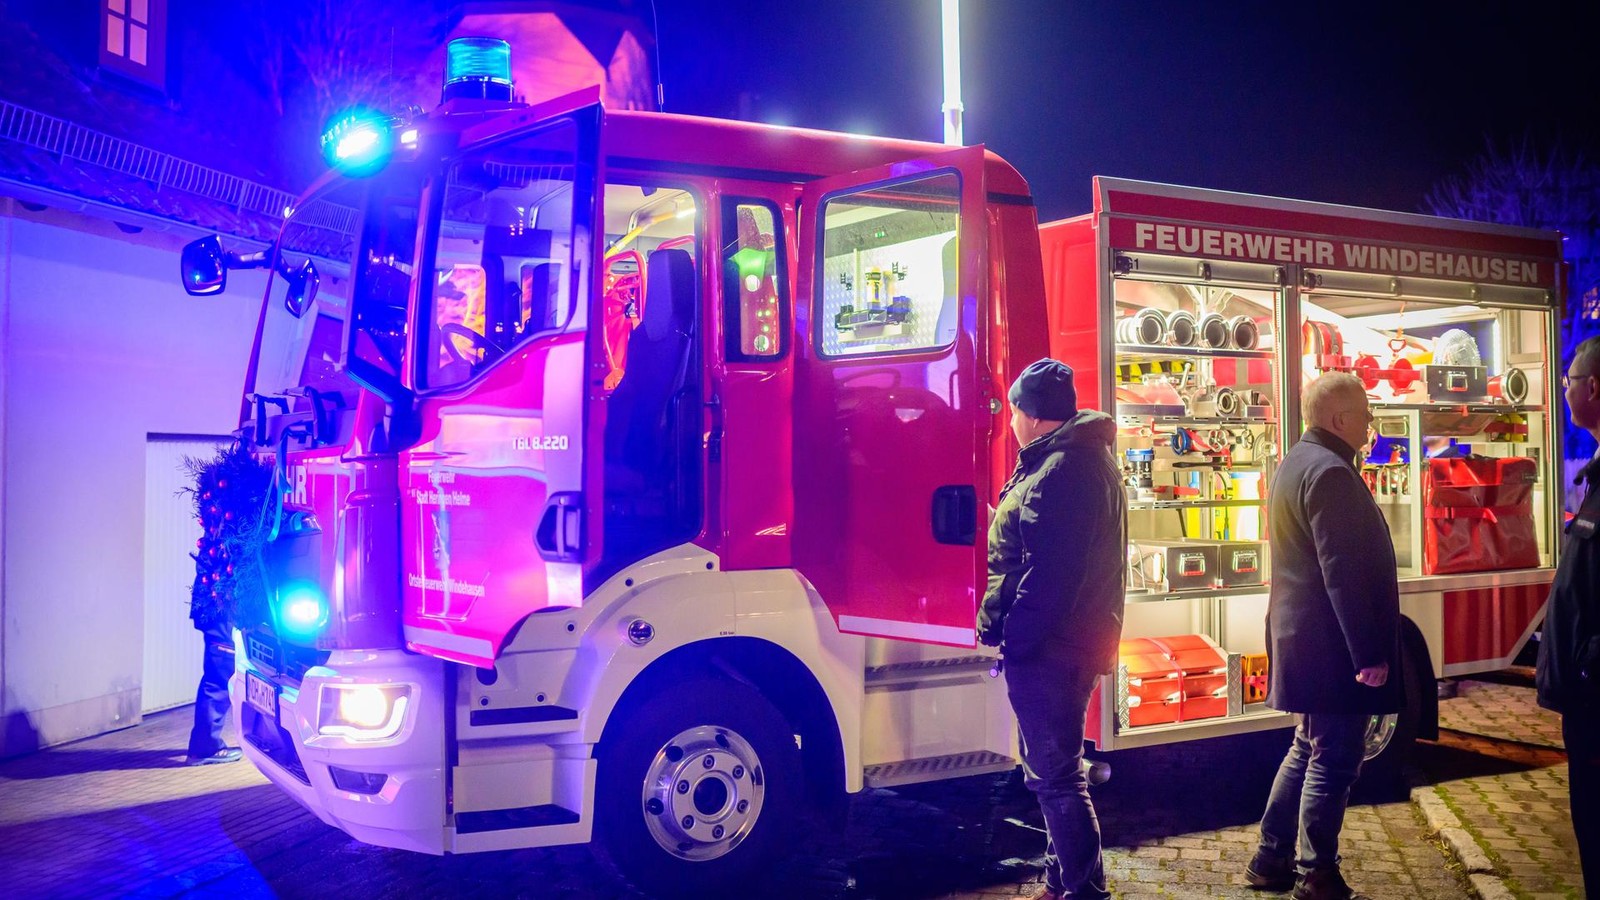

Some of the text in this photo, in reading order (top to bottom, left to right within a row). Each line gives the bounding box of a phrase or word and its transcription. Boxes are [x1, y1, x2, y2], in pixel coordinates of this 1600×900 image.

[1135, 222, 1538, 283] FEUERWEHR WINDEHAUSEN
[532, 435, 569, 450] 8.220
